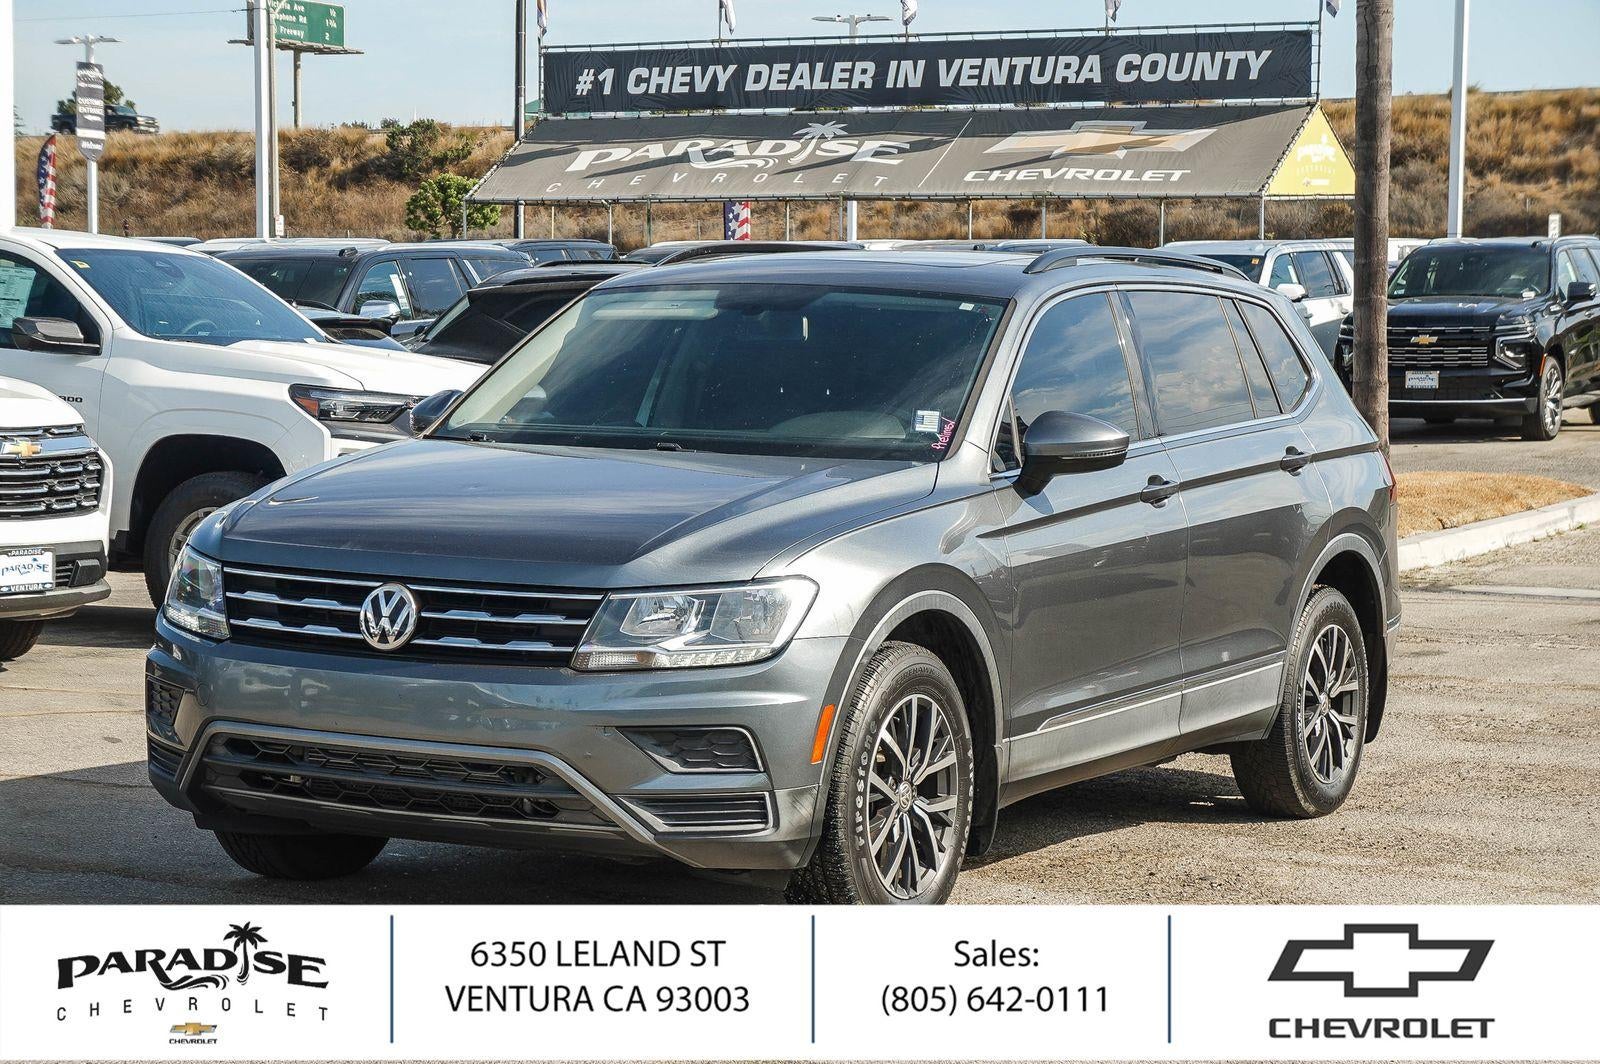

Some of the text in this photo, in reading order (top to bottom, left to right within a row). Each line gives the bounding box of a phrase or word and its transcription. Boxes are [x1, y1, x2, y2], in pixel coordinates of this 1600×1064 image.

[293, 3, 305, 12] Ave
[298, 14, 307, 24] Rd
[280, 26, 330, 40] Freeway 2
[576, 50, 1272, 95] #1 CHEVY DEALER IN VENTURA COUNTY
[565, 121, 911, 168] PARADISE
[546, 172, 888, 192] CHEVROLET
[963, 168, 1191, 182] CHEVROLET
[1, 557, 50, 577] PARADISE
[11, 583, 44, 591] VENTURA
[361, 583, 416, 650] VW
[855, 720, 877, 851] Firestone
